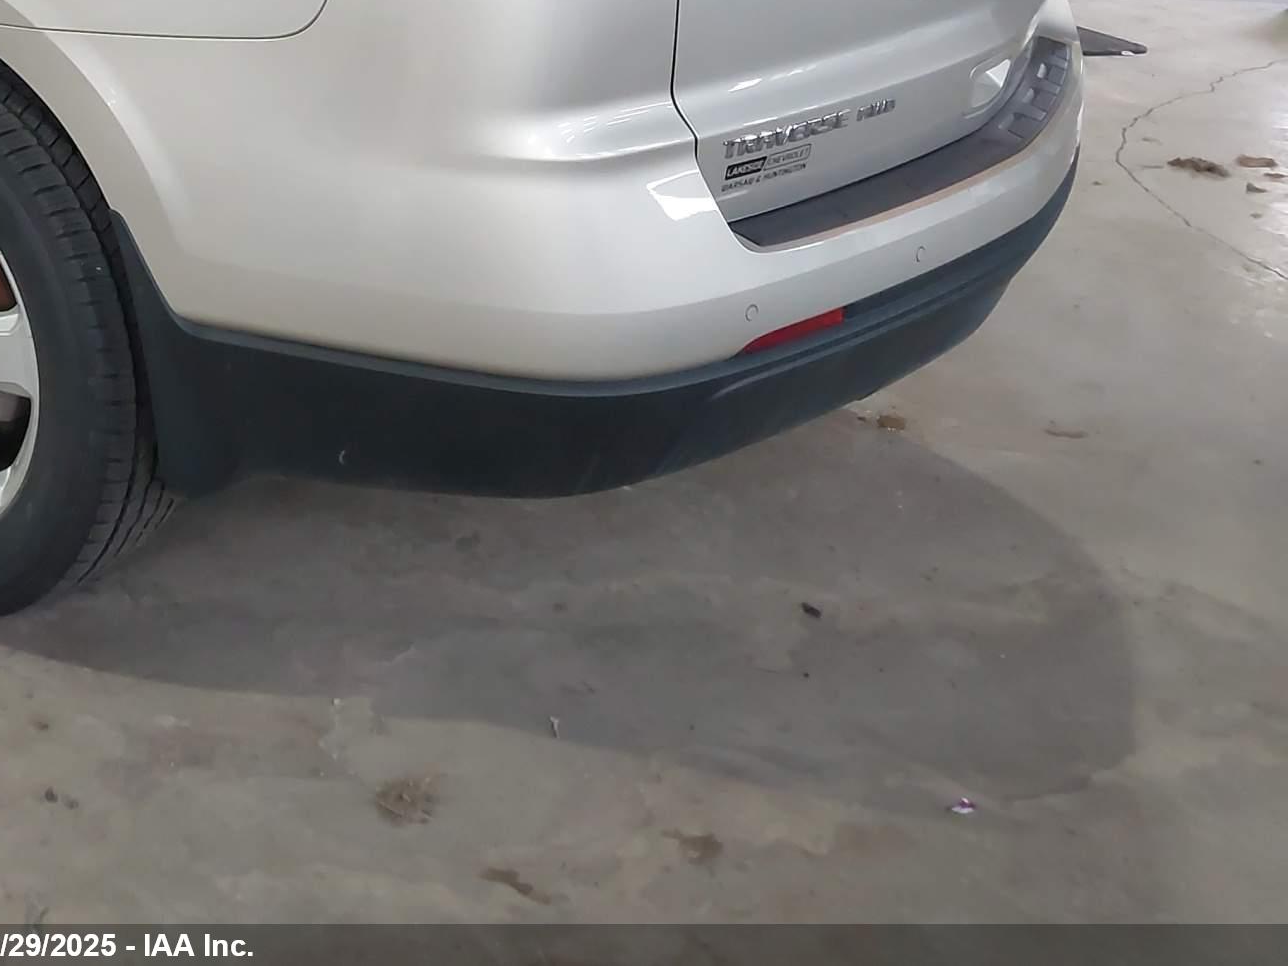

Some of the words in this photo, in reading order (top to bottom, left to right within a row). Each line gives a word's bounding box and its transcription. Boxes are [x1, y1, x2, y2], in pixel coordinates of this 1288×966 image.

[722, 108, 852, 160] TRAVERSE
[767, 147, 810, 167] CHEVROLET
[763, 162, 807, 180] HUNTINGTON
